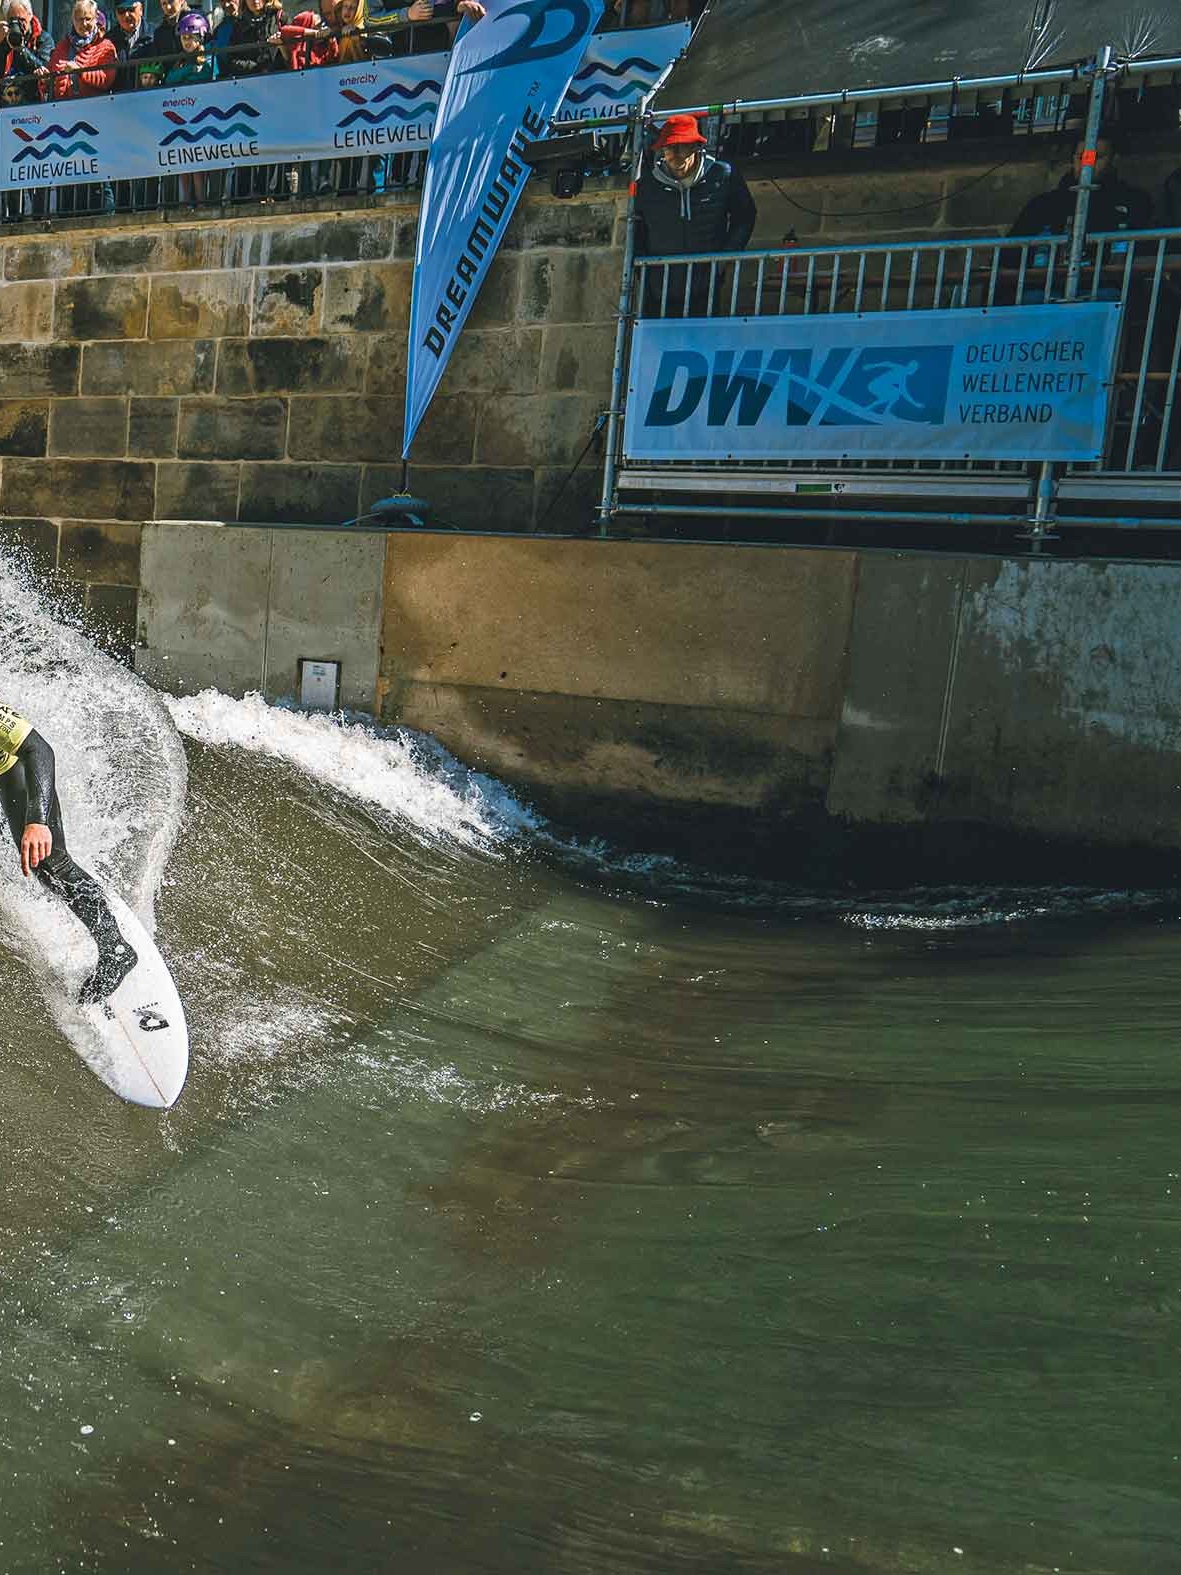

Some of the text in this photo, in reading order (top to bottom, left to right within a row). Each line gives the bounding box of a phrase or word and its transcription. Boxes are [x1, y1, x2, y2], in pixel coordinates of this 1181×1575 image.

[339, 73, 378, 87] enercity
[162, 97, 196, 108] enercity
[11, 114, 42, 125] enercity
[158, 141, 260, 167] LEINEWELLE
[10, 158, 99, 182] LEINEWELLE
[965, 341, 1086, 364] DEUTSCHER
[644, 347, 859, 427] DWV
[962, 372, 1088, 394] WELLENREIT
[958, 402, 1054, 424] VERBAND
